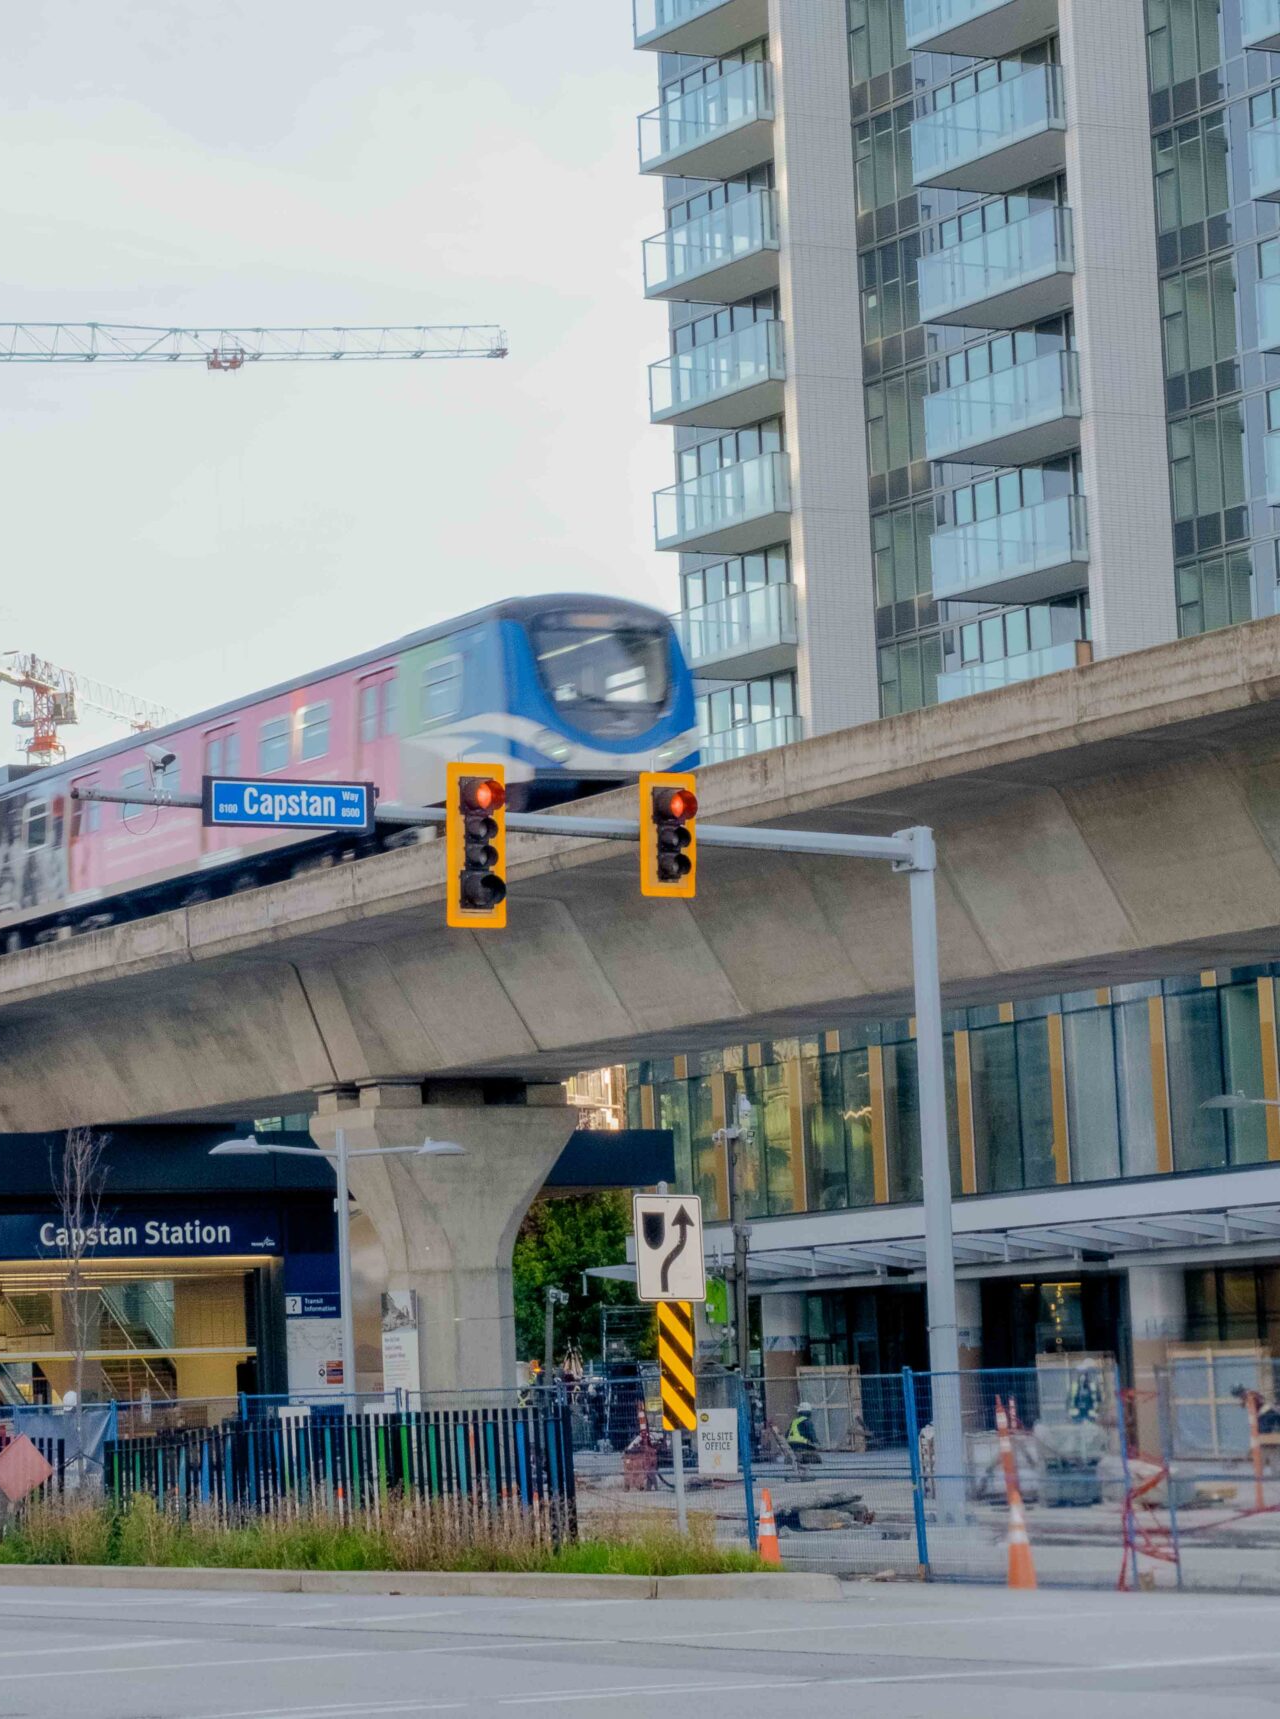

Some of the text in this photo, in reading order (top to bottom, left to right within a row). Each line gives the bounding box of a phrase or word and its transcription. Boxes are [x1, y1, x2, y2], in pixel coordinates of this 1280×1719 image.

[219, 787, 360, 822] 8100 Capstan Way
[341, 807, 360, 818] 8500
[39, 1220, 232, 1251] Capstan Station
[702, 1432, 734, 1441] PCL SITE
[705, 1442, 731, 1451] OFFICE
